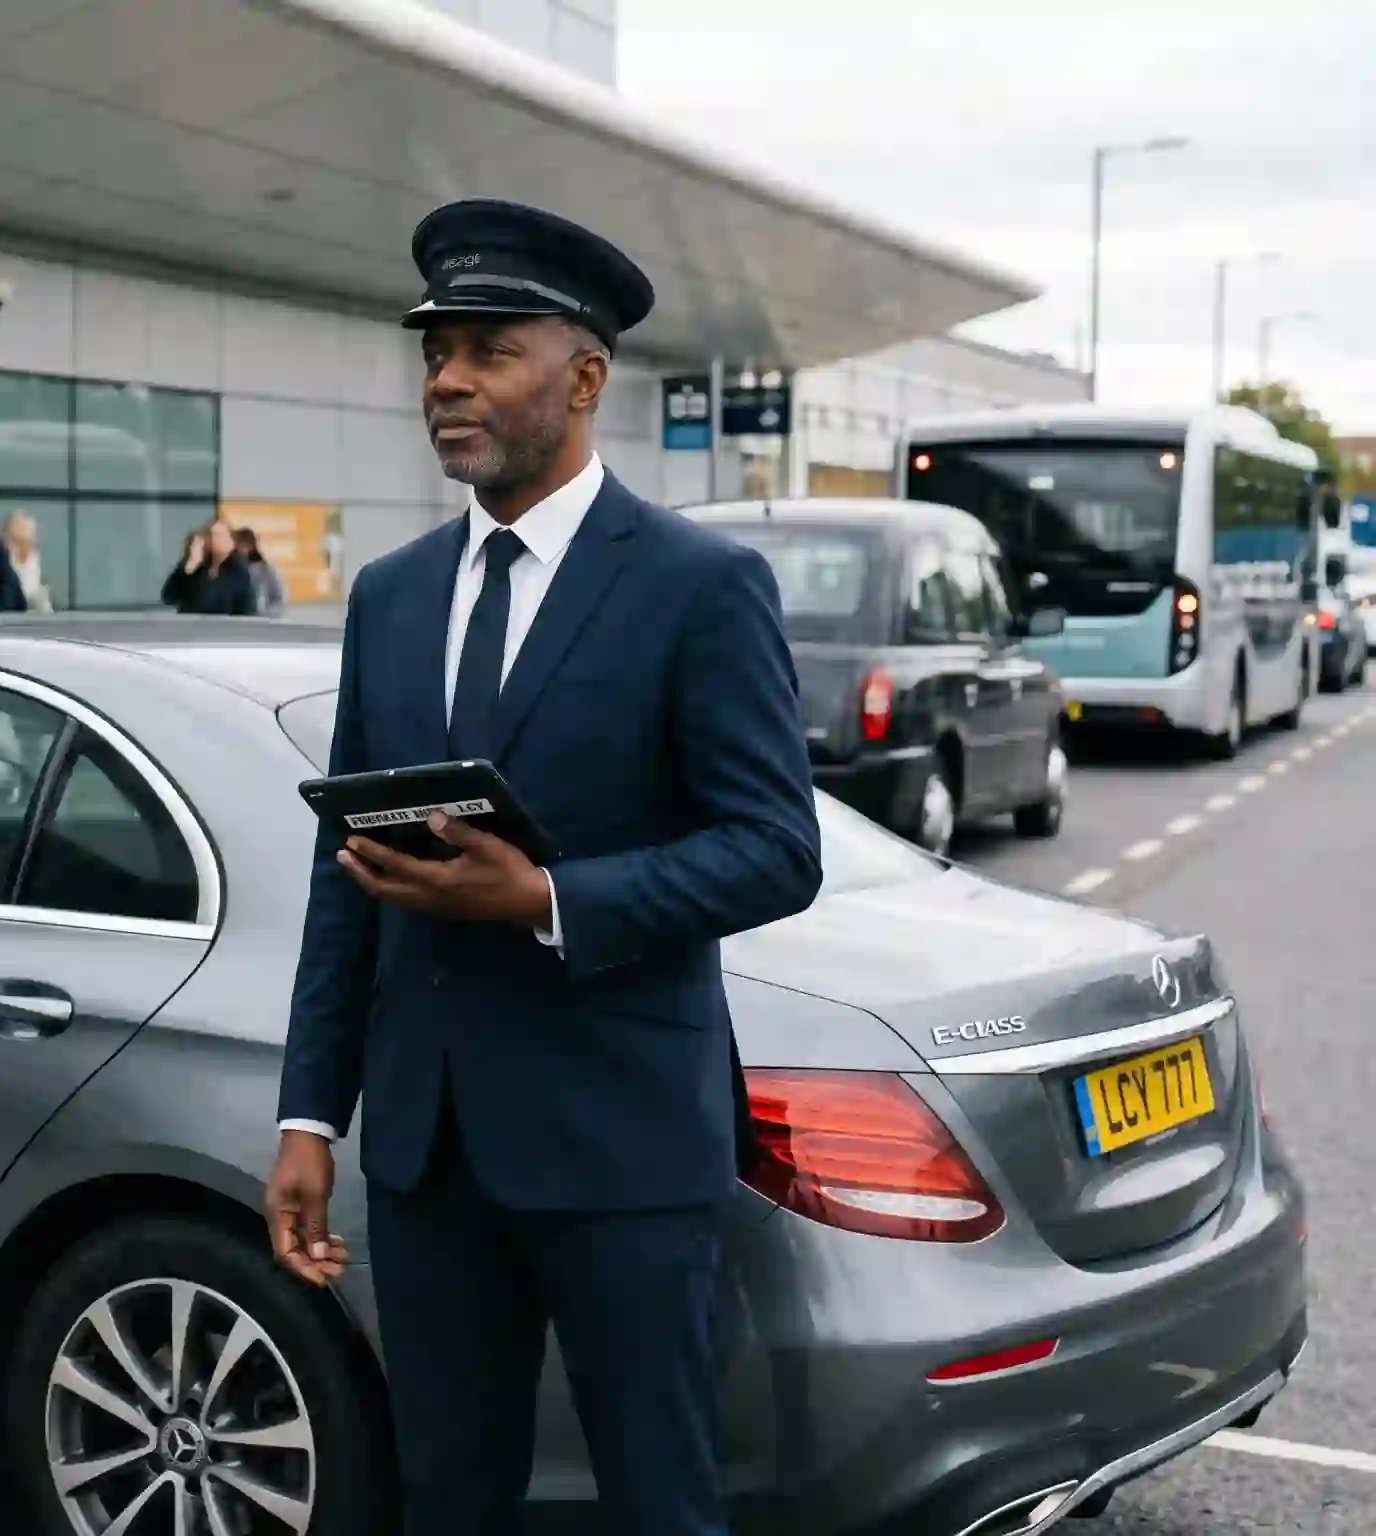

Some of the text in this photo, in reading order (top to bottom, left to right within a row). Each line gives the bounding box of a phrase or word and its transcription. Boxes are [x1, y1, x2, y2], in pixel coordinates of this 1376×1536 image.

[930, 1014, 1027, 1046] E-CLASS
[1099, 1049, 1198, 1134] LCY 777
